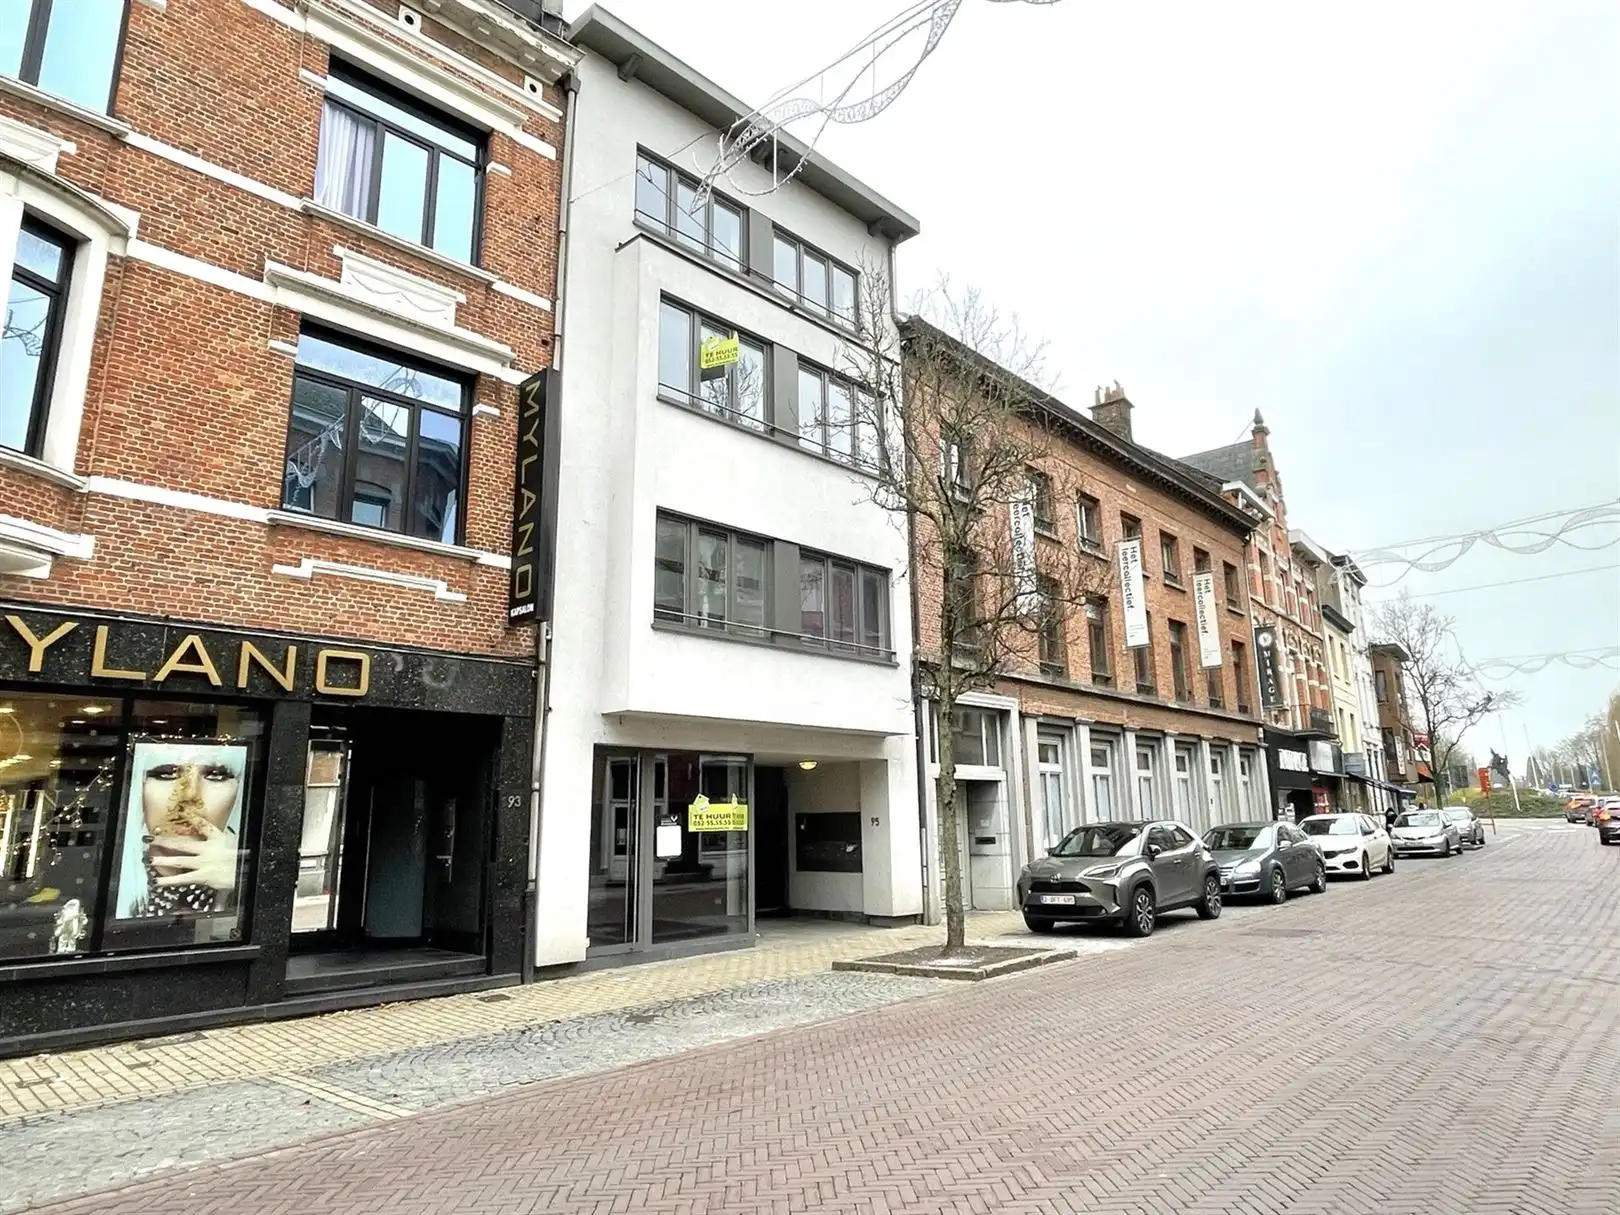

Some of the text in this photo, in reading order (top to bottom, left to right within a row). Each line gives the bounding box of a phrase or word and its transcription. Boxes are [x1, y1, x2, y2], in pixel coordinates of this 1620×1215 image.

[715, 347, 738, 356] HUUR
[515, 379, 541, 599] MYLANO
[1130, 546, 1138, 564] Het
[1203, 578, 1212, 594] Het
[507, 795, 521, 808] 93
[706, 812, 732, 820] HUUR
